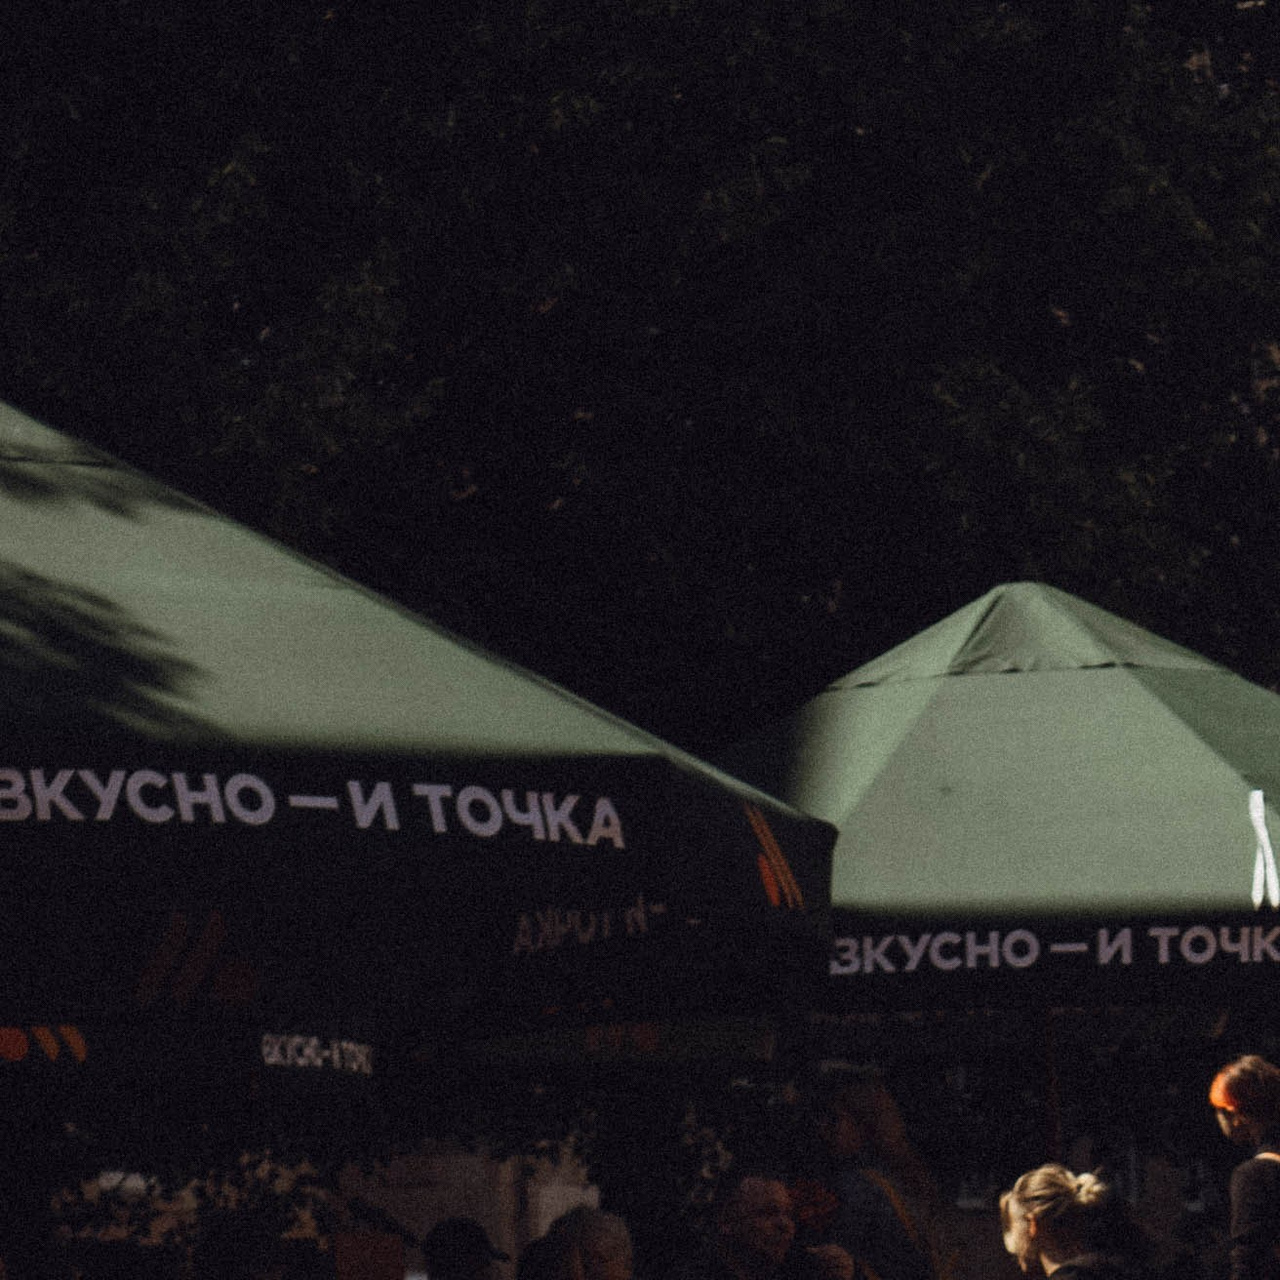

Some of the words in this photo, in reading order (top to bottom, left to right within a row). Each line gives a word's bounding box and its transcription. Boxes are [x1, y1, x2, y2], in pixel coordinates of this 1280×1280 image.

[346, 779, 401, 832] И
[411, 783, 627, 850] ТОЧКА
[1096, 927, 1133, 966] И
